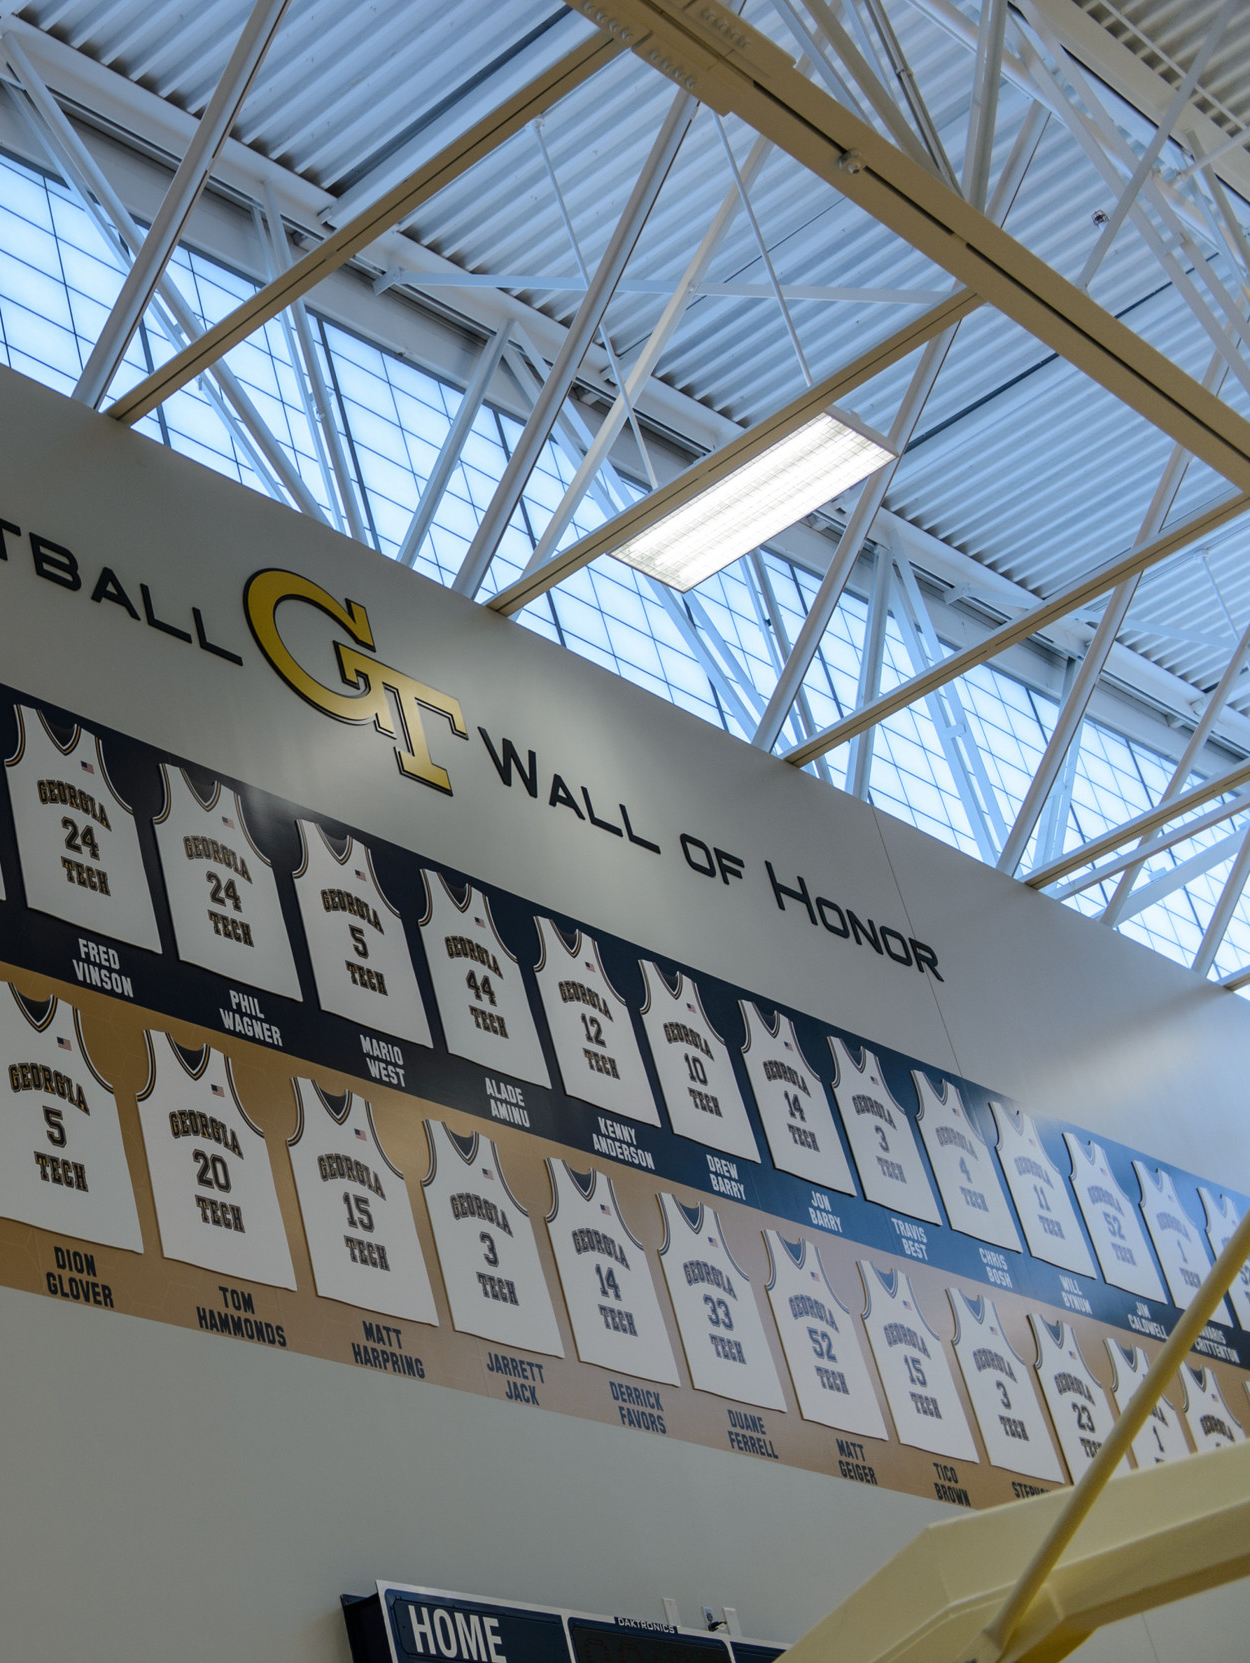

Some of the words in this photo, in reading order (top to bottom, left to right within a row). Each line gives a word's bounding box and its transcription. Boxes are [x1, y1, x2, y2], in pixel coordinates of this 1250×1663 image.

[243, 568, 469, 797] GT
[477, 726, 660, 854] WALL
[680, 833, 744, 885] OF
[765, 860, 944, 982] HONOR
[37, 779, 112, 832] GEORGIA
[60, 855, 111, 897] TECH
[78, 938, 120, 970] FRED
[72, 959, 133, 998] VINSON
[229, 989, 265, 1019] PHIL
[219, 1008, 283, 1047] WAGNER
[359, 1034, 403, 1066] MARIO
[366, 1057, 405, 1088] WEST
[8, 1063, 90, 1116] GEORGIA
[485, 1077, 525, 1107] ALADE
[42, 1105, 67, 1148] 5
[490, 1098, 530, 1128] AMINU
[169, 1109, 244, 1160] GEORGIA
[598, 1117, 637, 1145] KENNY
[592, 1133, 655, 1170] ANDERSON
[706, 1154, 738, 1180] DREW
[34, 1151, 89, 1192] TECH
[709, 1174, 746, 1200] BARRY
[195, 1194, 245, 1234] TECH
[811, 1191, 832, 1212] JON
[808, 1208, 842, 1233] BARRY
[54, 1246, 97, 1278] DION
[46, 1272, 114, 1309] GLOVER
[219, 1286, 255, 1315] TOM
[196, 1306, 287, 1348] HAMMONDS
[362, 1320, 402, 1350] MATT
[351, 1342, 425, 1379] HARPRING
[487, 1352, 544, 1384] JARRETT
[505, 1379, 540, 1406] JACK
[609, 1380, 664, 1412] DERRICK
[619, 1406, 667, 1435] FAVORS
[727, 1409, 766, 1436] DUANE
[727, 1430, 779, 1460] FERRELL
[836, 1438, 866, 1462] MATT
[838, 1459, 878, 1486] GEIGER
[933, 1462, 958, 1484] TICO
[934, 1482, 971, 1508] BROWN
[408, 1605, 507, 1663] HOME
[618, 1617, 675, 1634] DAKTRONICS
